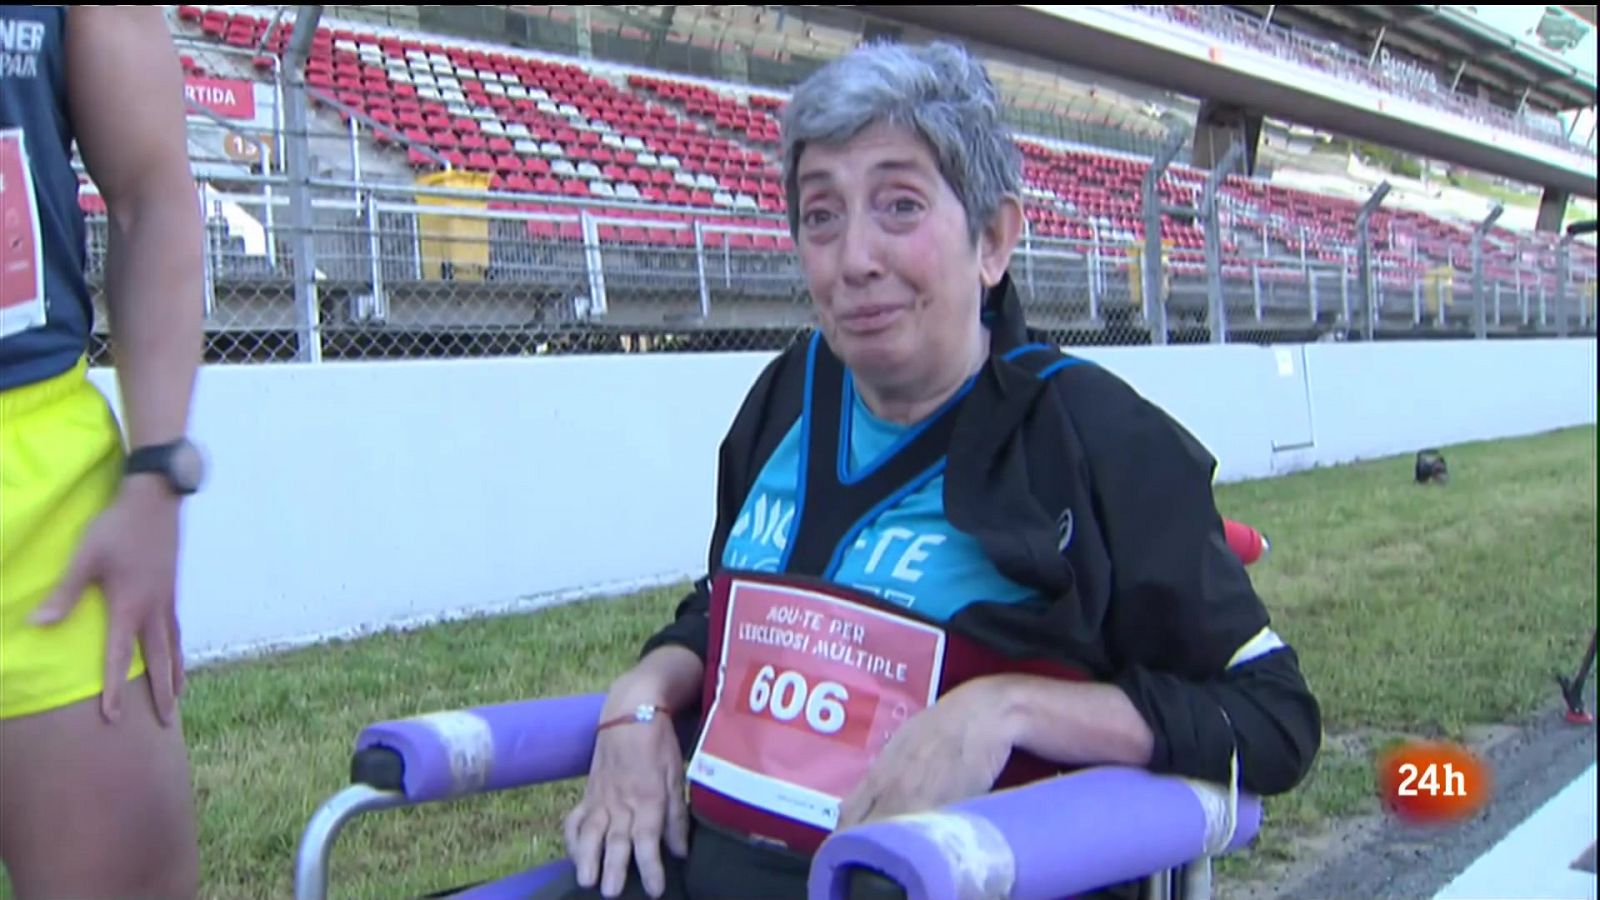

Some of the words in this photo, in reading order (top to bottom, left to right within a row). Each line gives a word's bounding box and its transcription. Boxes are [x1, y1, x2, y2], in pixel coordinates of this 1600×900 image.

[0, 19, 45, 51] NER
[829, 618, 866, 645] PER
[749, 664, 850, 735] 606
